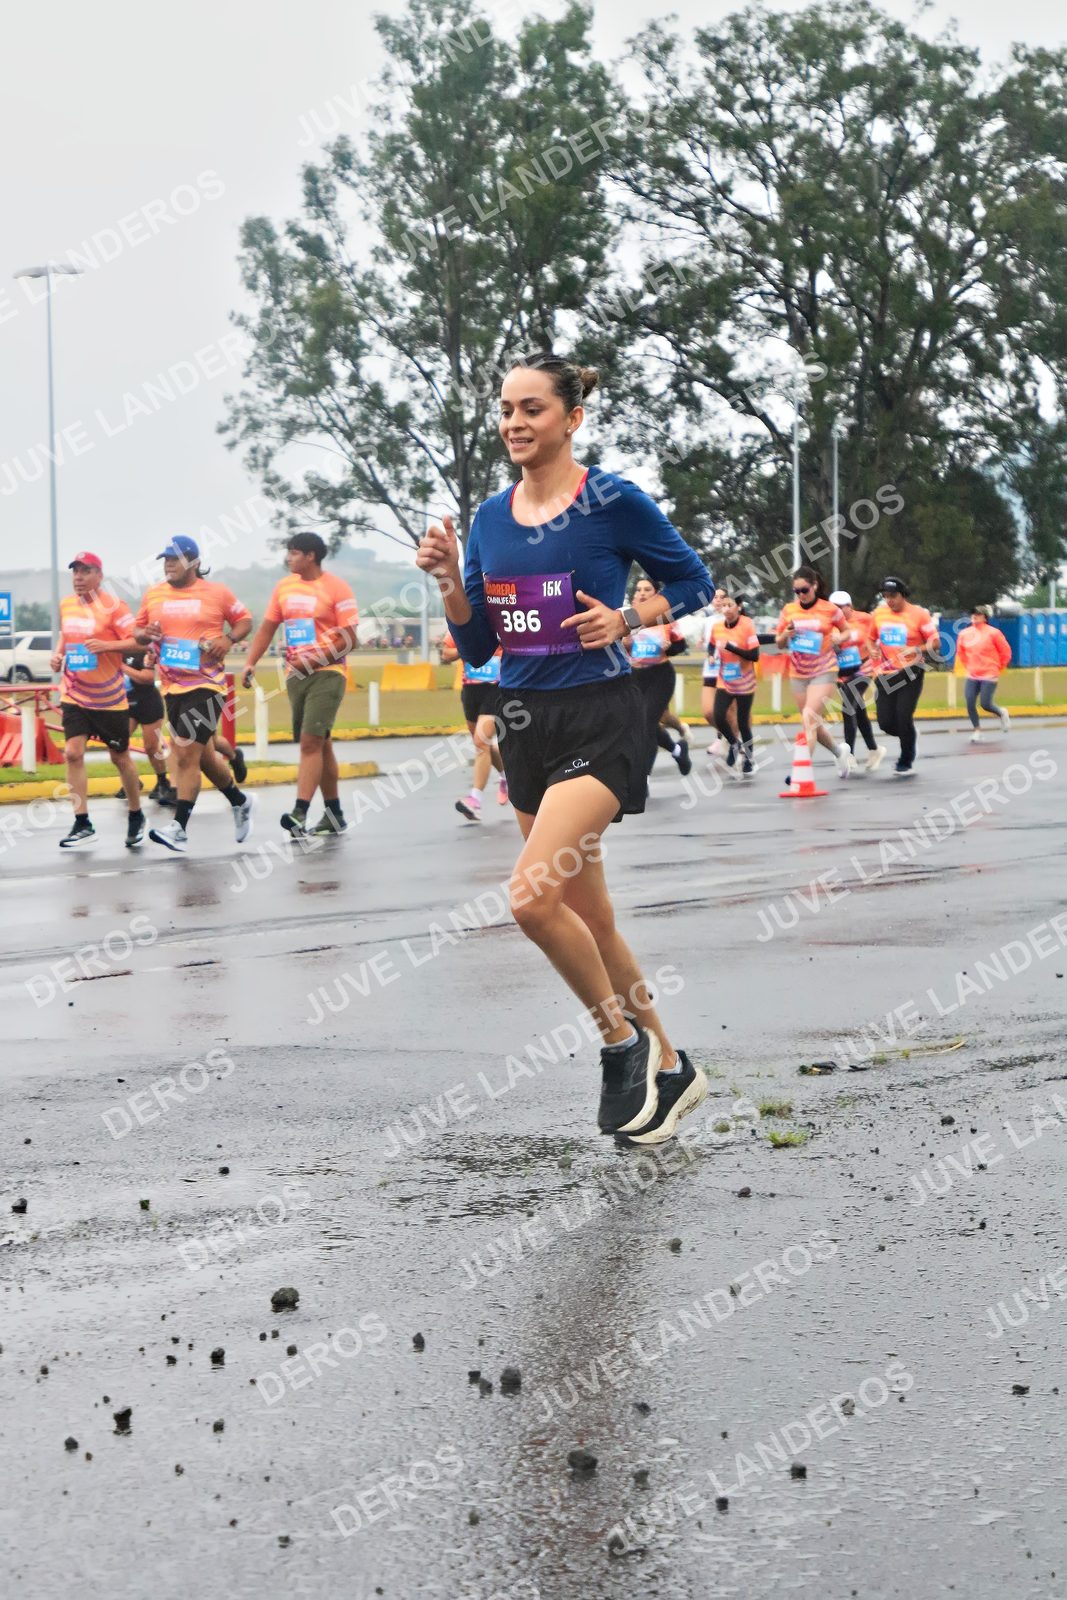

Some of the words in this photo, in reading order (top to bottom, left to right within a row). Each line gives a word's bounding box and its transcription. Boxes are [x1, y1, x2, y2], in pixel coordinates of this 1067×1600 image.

[542, 580, 562, 597] 15K
[501, 610, 541, 632] 386
[166, 648, 191, 661] 2249
